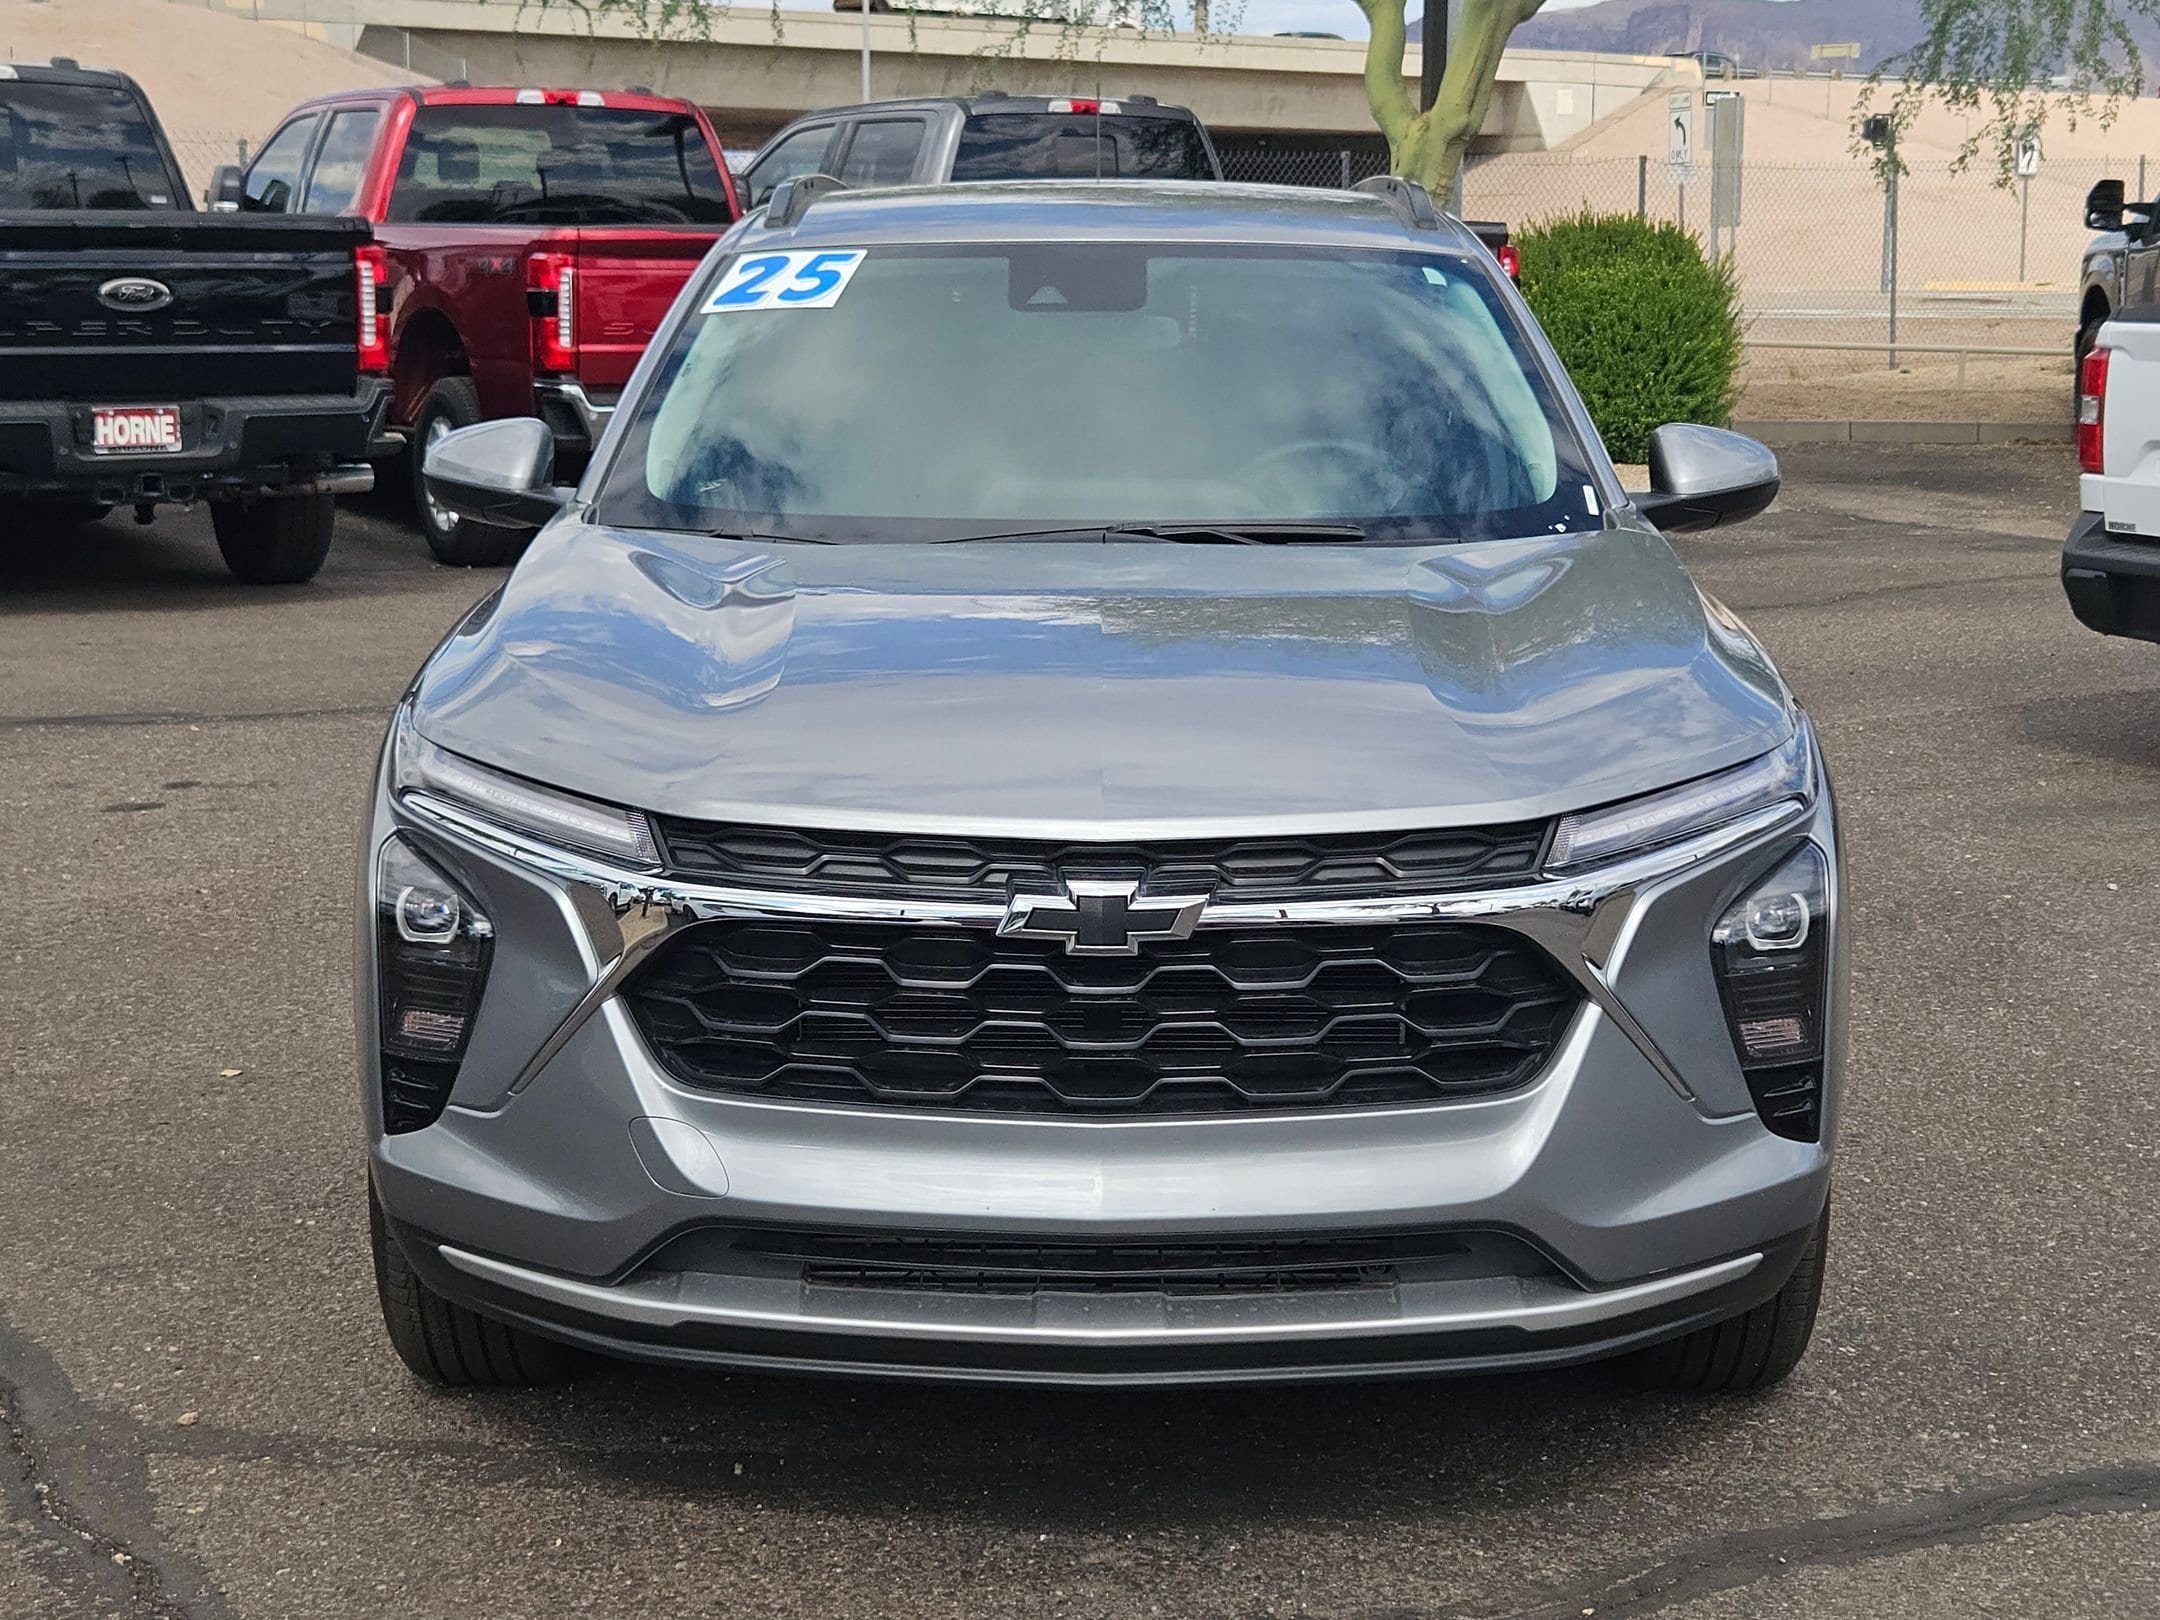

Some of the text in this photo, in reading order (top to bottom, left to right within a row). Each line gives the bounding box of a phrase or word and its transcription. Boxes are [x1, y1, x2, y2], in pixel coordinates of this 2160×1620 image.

[713, 254, 859, 306] 25
[119, 285, 155, 301] Ford
[173, 320, 333, 336] DUTY
[95, 414, 176, 445] HORNE
